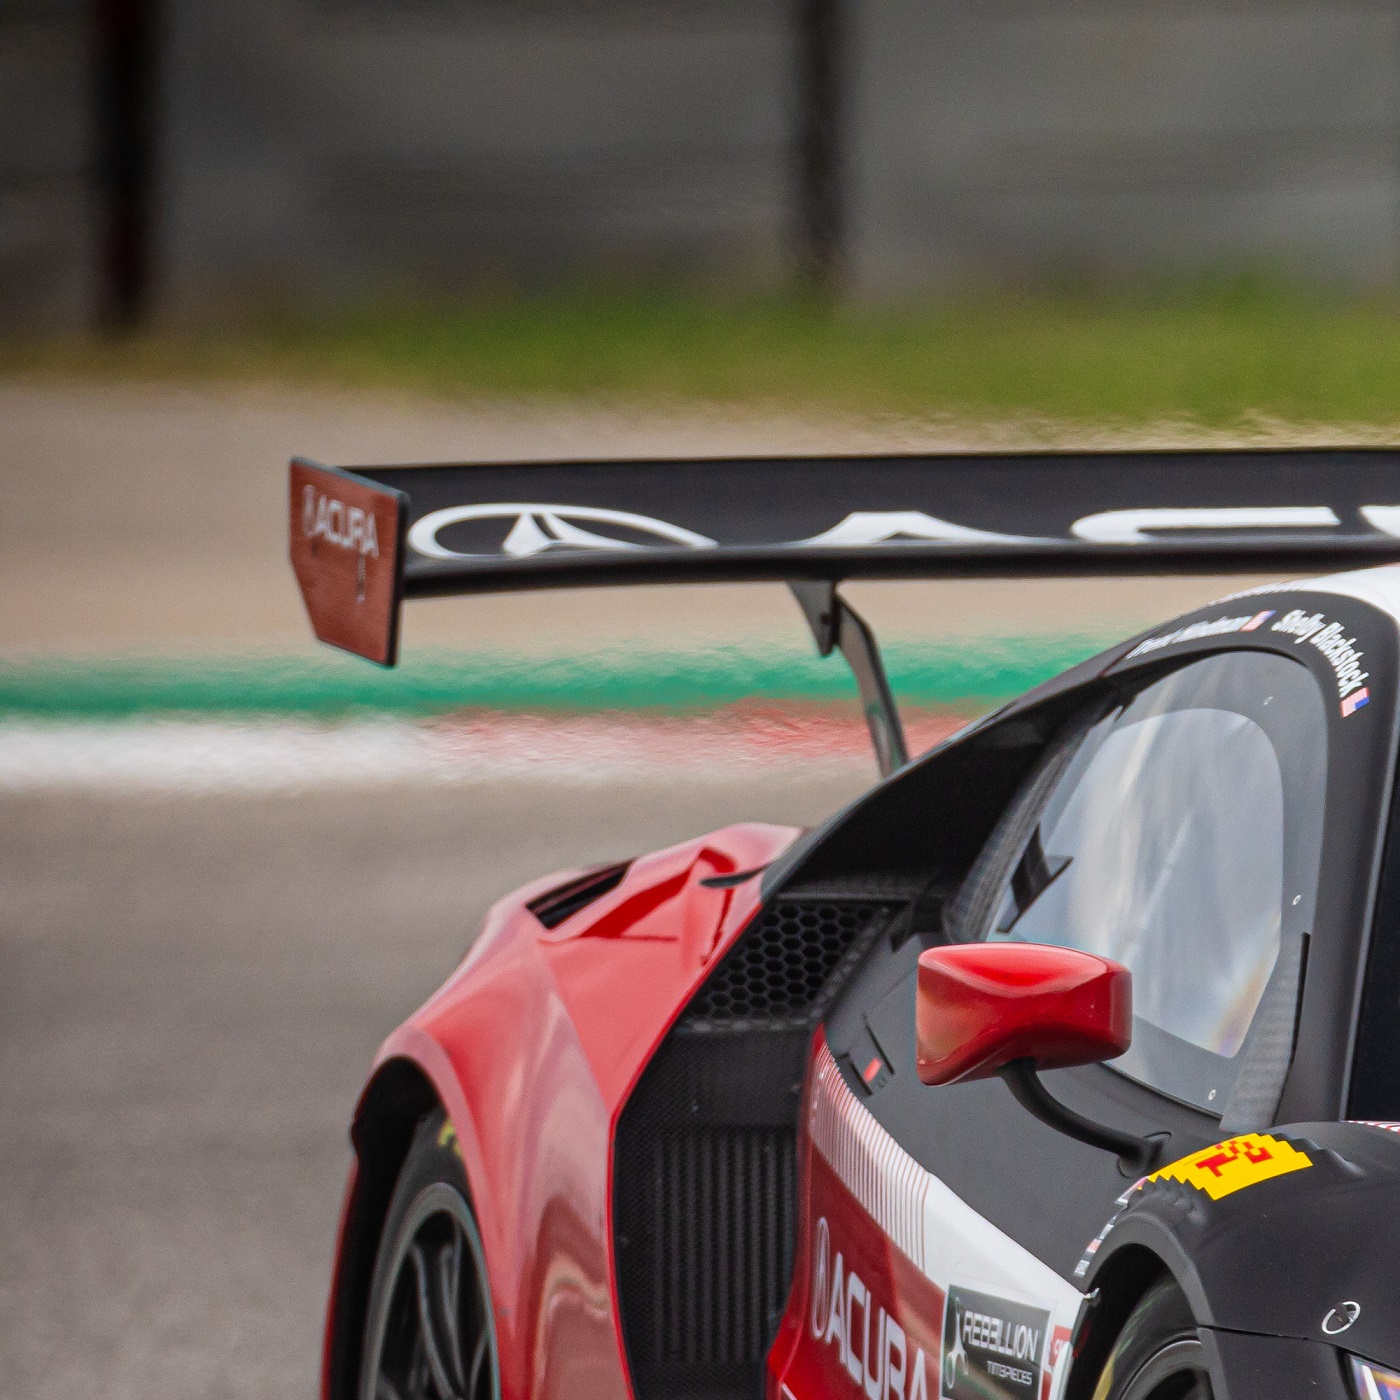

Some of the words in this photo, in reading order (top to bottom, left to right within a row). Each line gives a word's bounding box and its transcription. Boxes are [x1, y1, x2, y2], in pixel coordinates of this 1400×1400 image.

[315, 495, 380, 560] ACURA
[1271, 609, 1327, 644] Shelby
[1309, 622, 1370, 698] Blackstock
